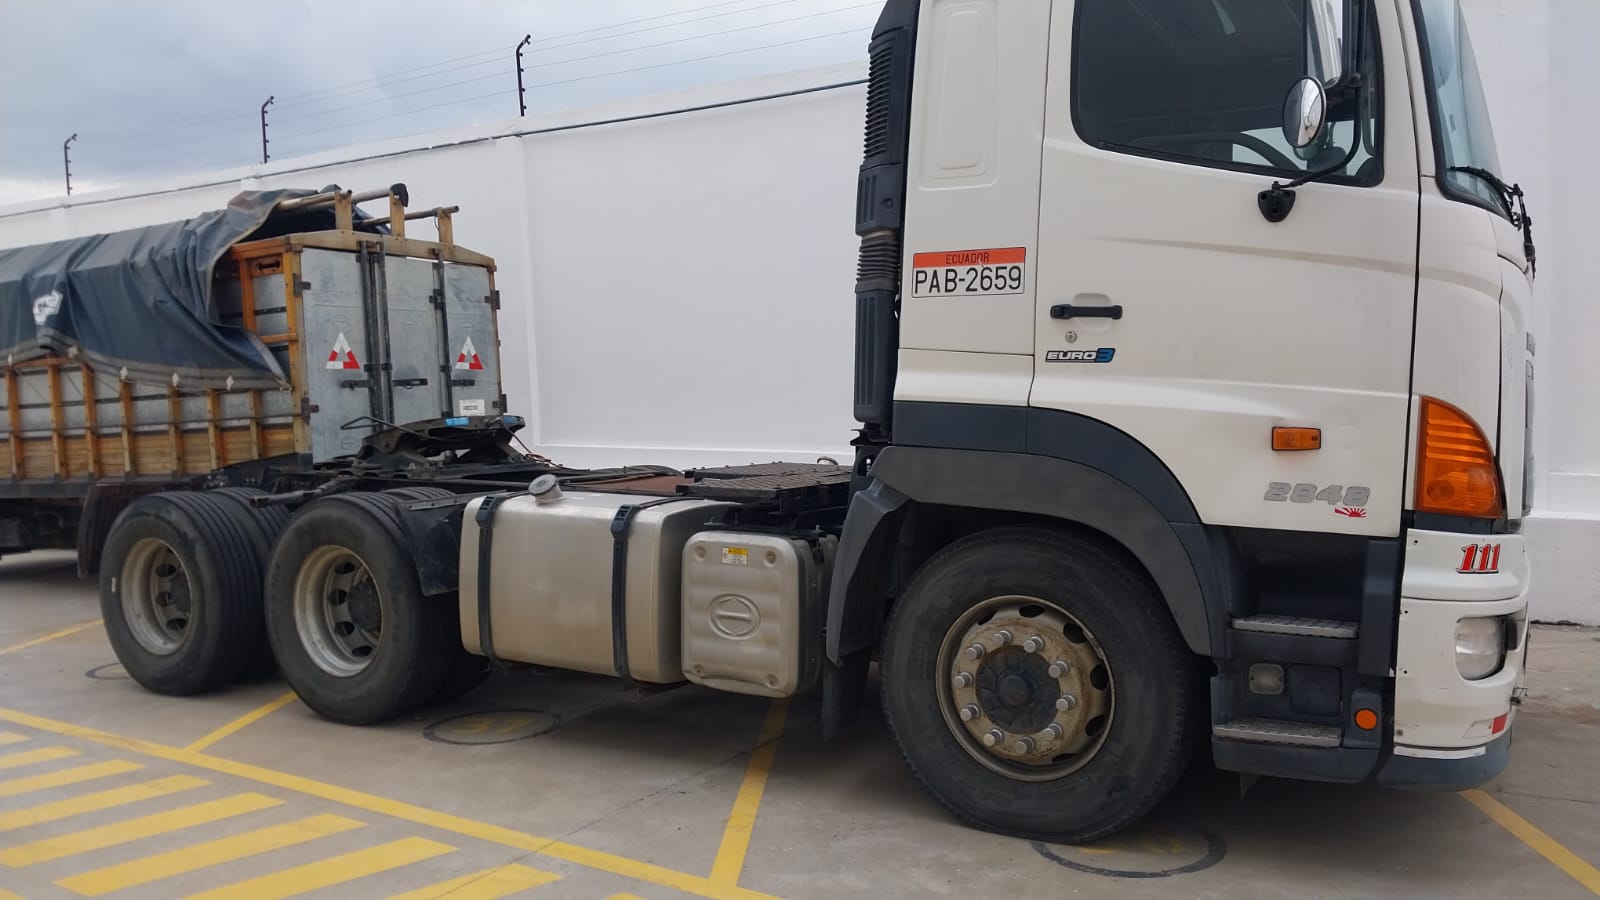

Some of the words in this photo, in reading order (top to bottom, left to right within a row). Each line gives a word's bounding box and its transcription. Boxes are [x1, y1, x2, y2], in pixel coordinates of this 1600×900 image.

[945, 251, 991, 265] ECUADOR
[914, 265, 1022, 294] PAB-2659
[1264, 481, 1371, 507] 2848
[1456, 543, 1501, 575] 111
